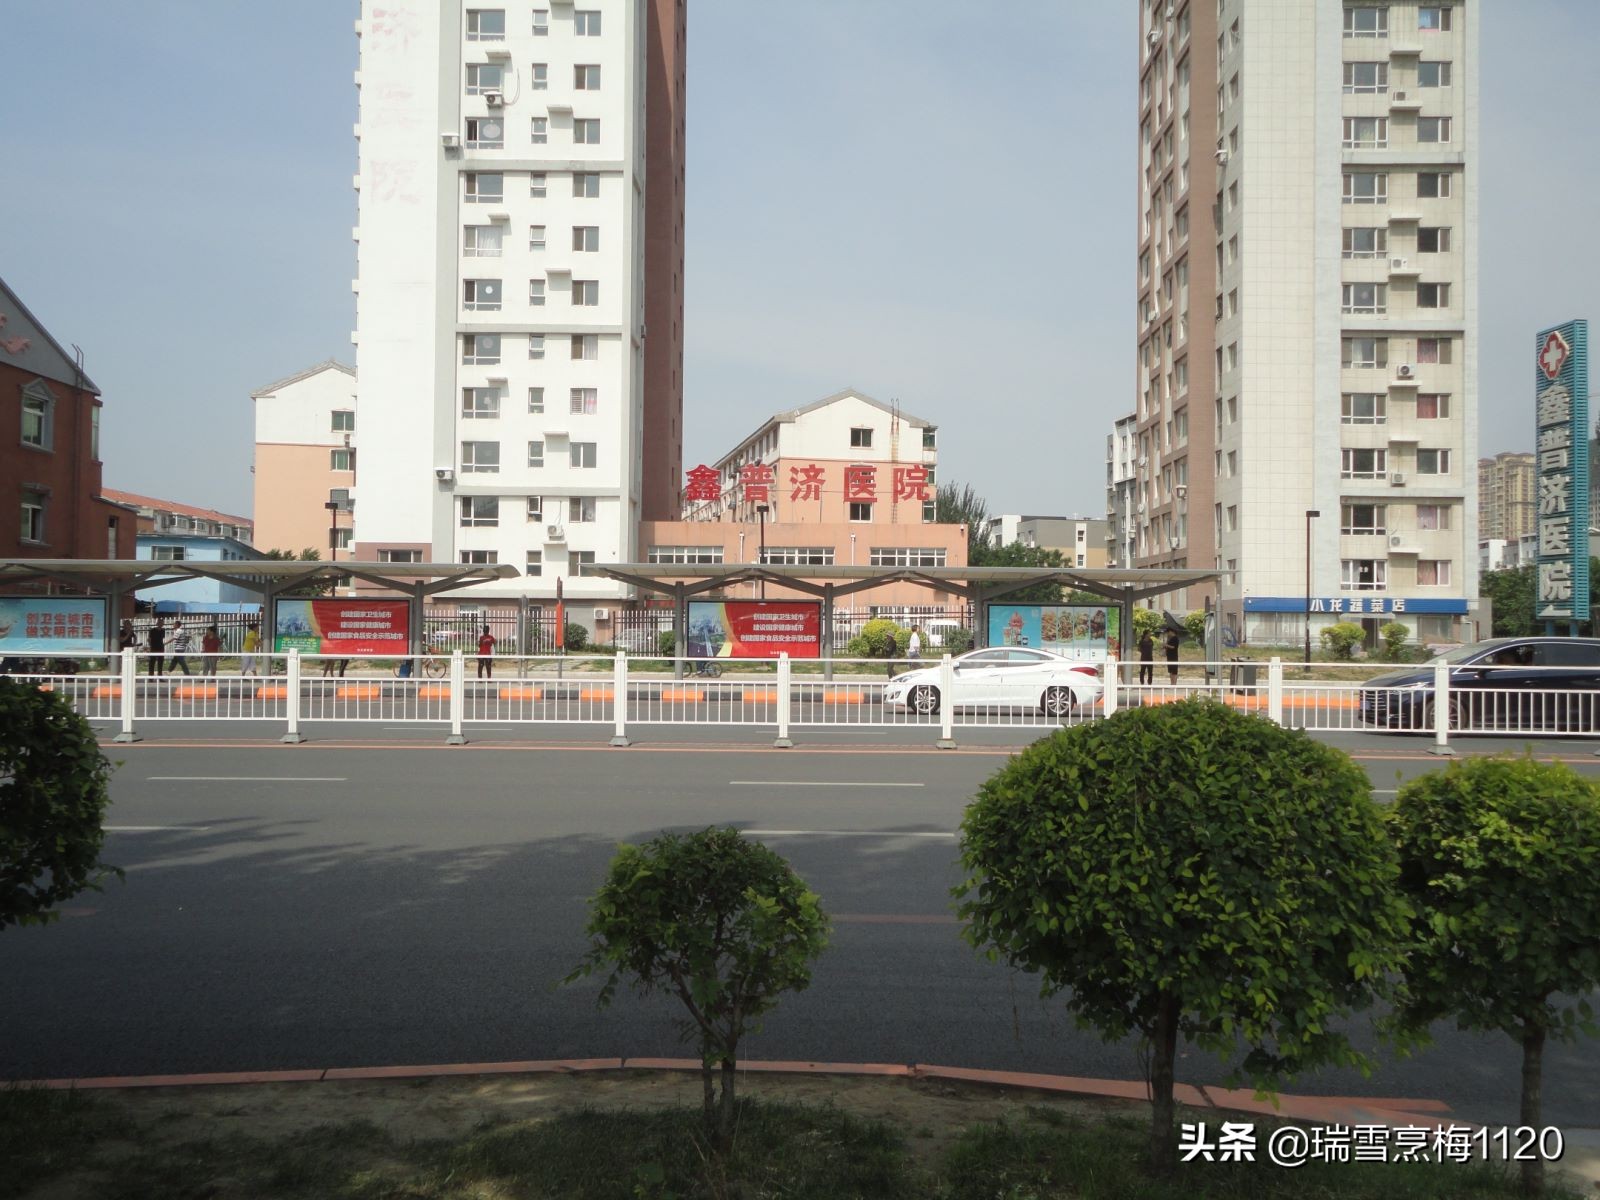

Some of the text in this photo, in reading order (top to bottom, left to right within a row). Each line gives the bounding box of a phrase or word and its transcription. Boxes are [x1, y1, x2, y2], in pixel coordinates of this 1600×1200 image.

[685, 464, 930, 503] 鑫普济医院
[1538, 384, 1571, 601] 鑫普济医院
